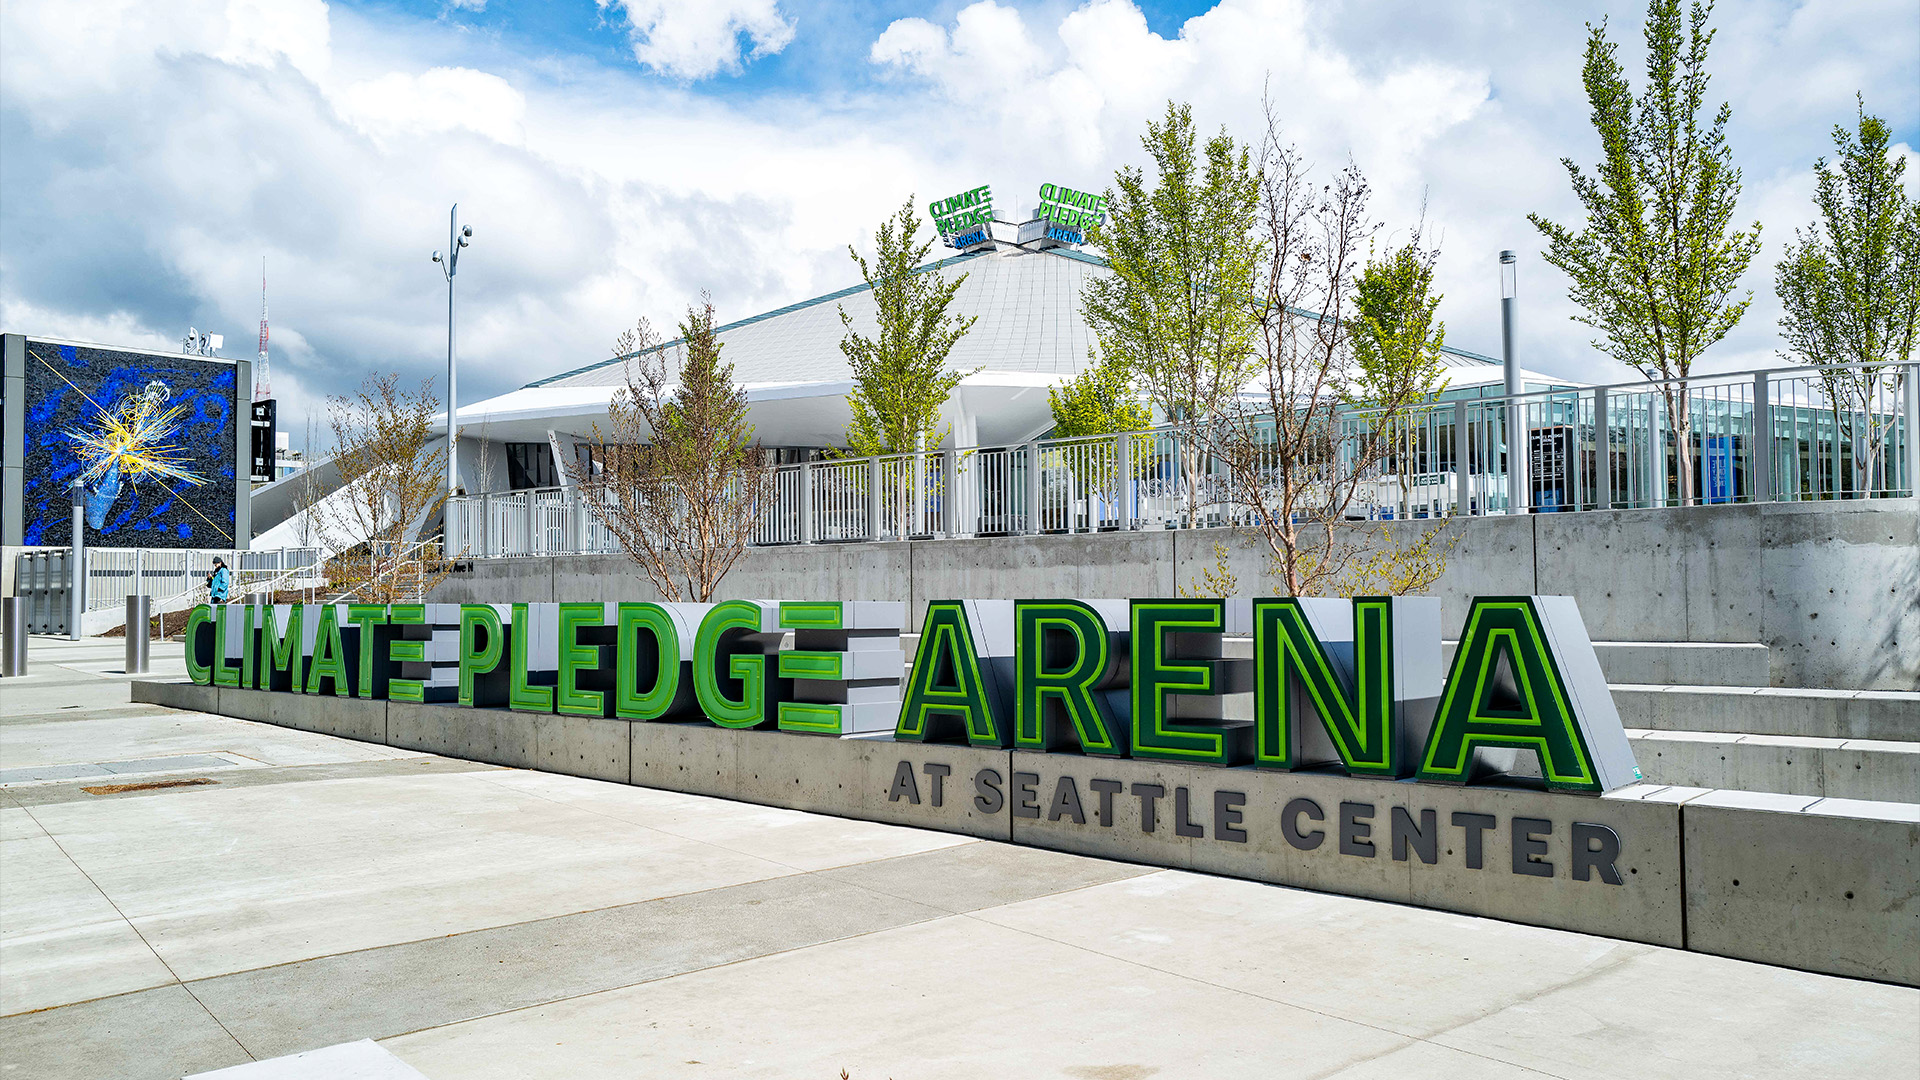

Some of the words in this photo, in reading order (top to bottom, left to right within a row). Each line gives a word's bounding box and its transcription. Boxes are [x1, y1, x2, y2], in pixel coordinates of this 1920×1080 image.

[929, 185, 993, 219] CLIMATE
[1040, 183, 1108, 214] CLIMATE
[936, 205, 994, 236] PLEDGE
[1038, 202, 1102, 230] PLEDGE
[955, 230, 987, 249] ARENA
[1047, 228, 1082, 245] ARENA
[184, 603, 426, 703] CLIMATE
[458, 599, 843, 734] PLEDGE
[894, 595, 1602, 792] ARENA
[888, 761, 950, 808] AT
[973, 769, 1247, 843] SEATTLE
[1280, 798, 1624, 887] CENTER
